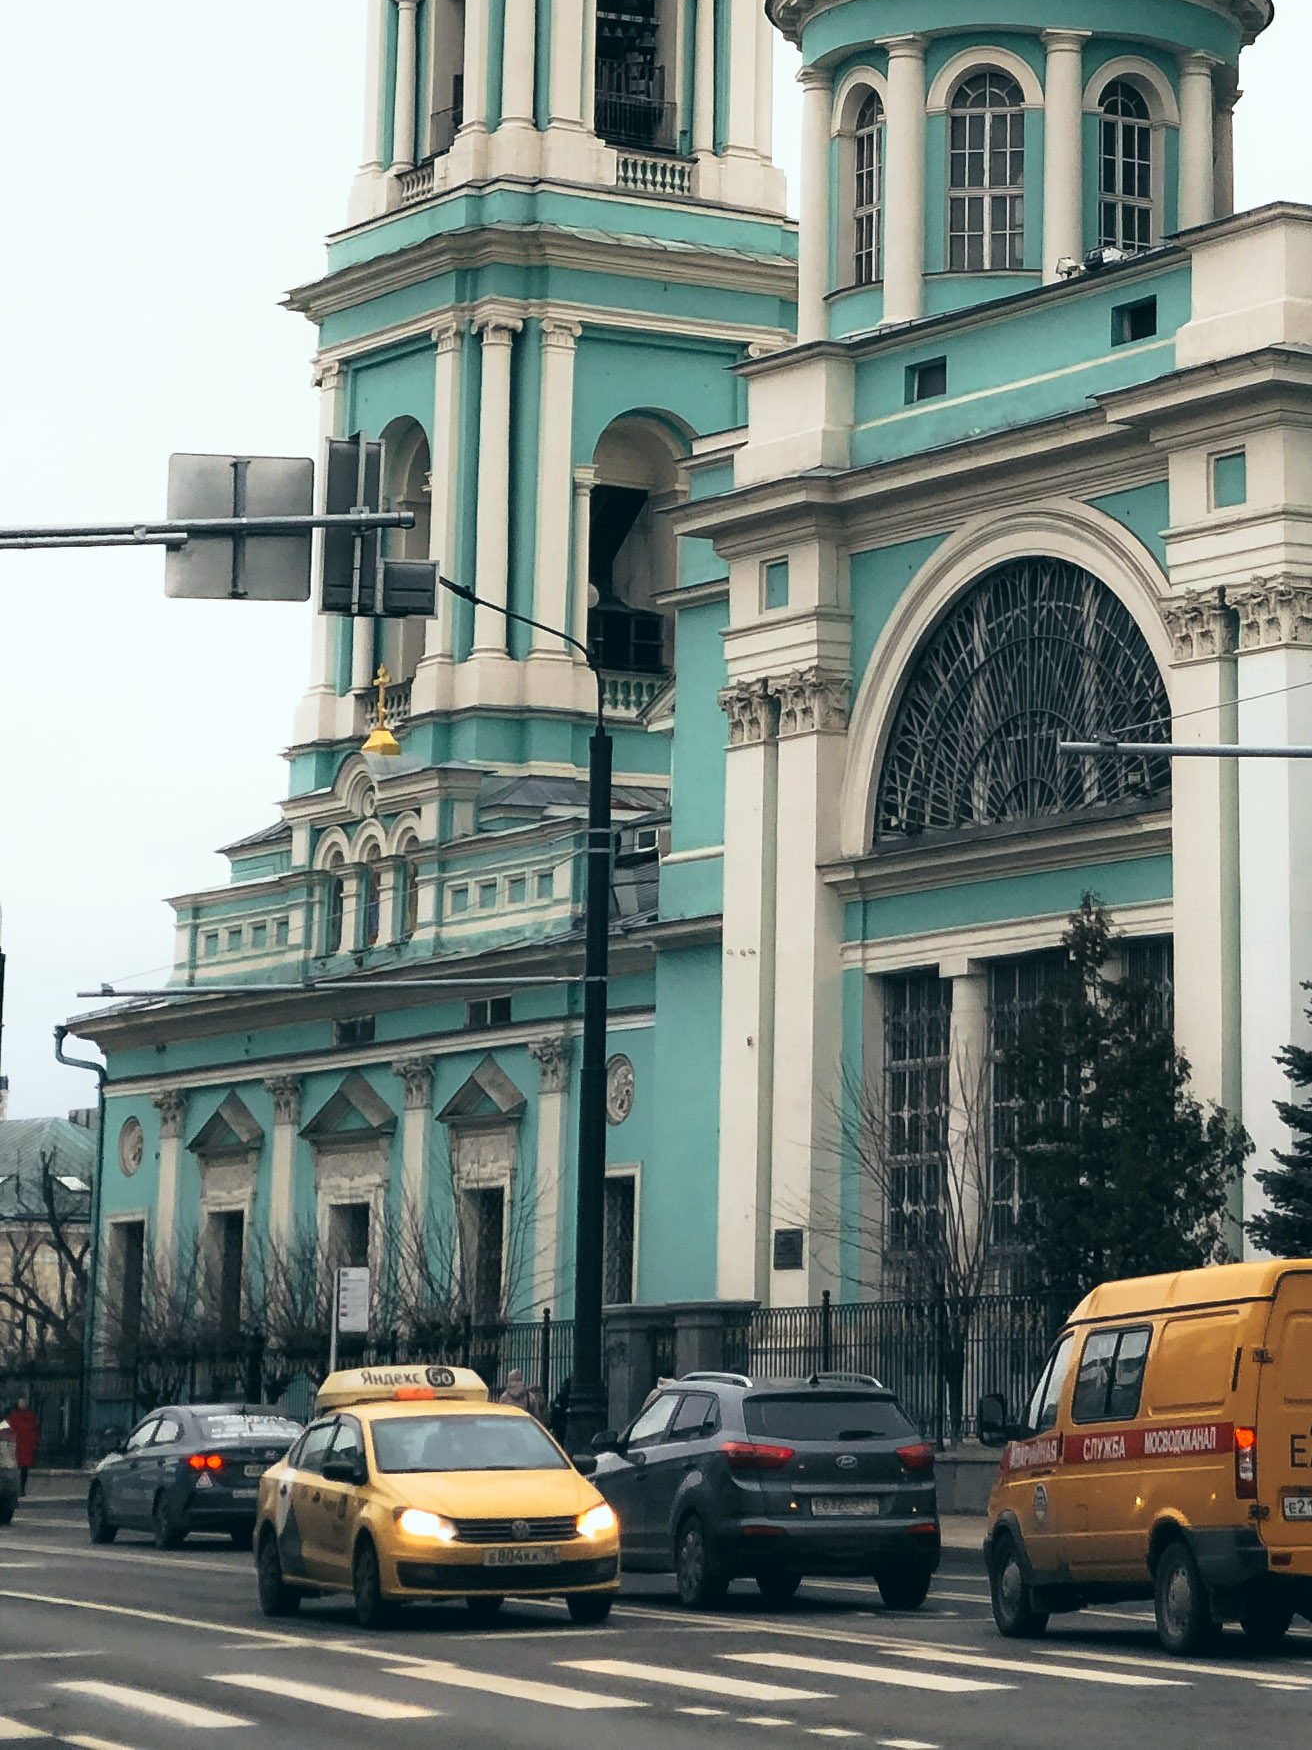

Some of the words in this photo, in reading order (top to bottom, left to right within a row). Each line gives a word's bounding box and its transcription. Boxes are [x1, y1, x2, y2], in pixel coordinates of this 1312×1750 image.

[361, 1370, 420, 1386] Яндекс
[429, 1369, 452, 1385] Go
[1082, 1435, 1126, 1461] СЛУЖБА
[1144, 1426, 1216, 1454] МОСВОДОКАНАЛ
